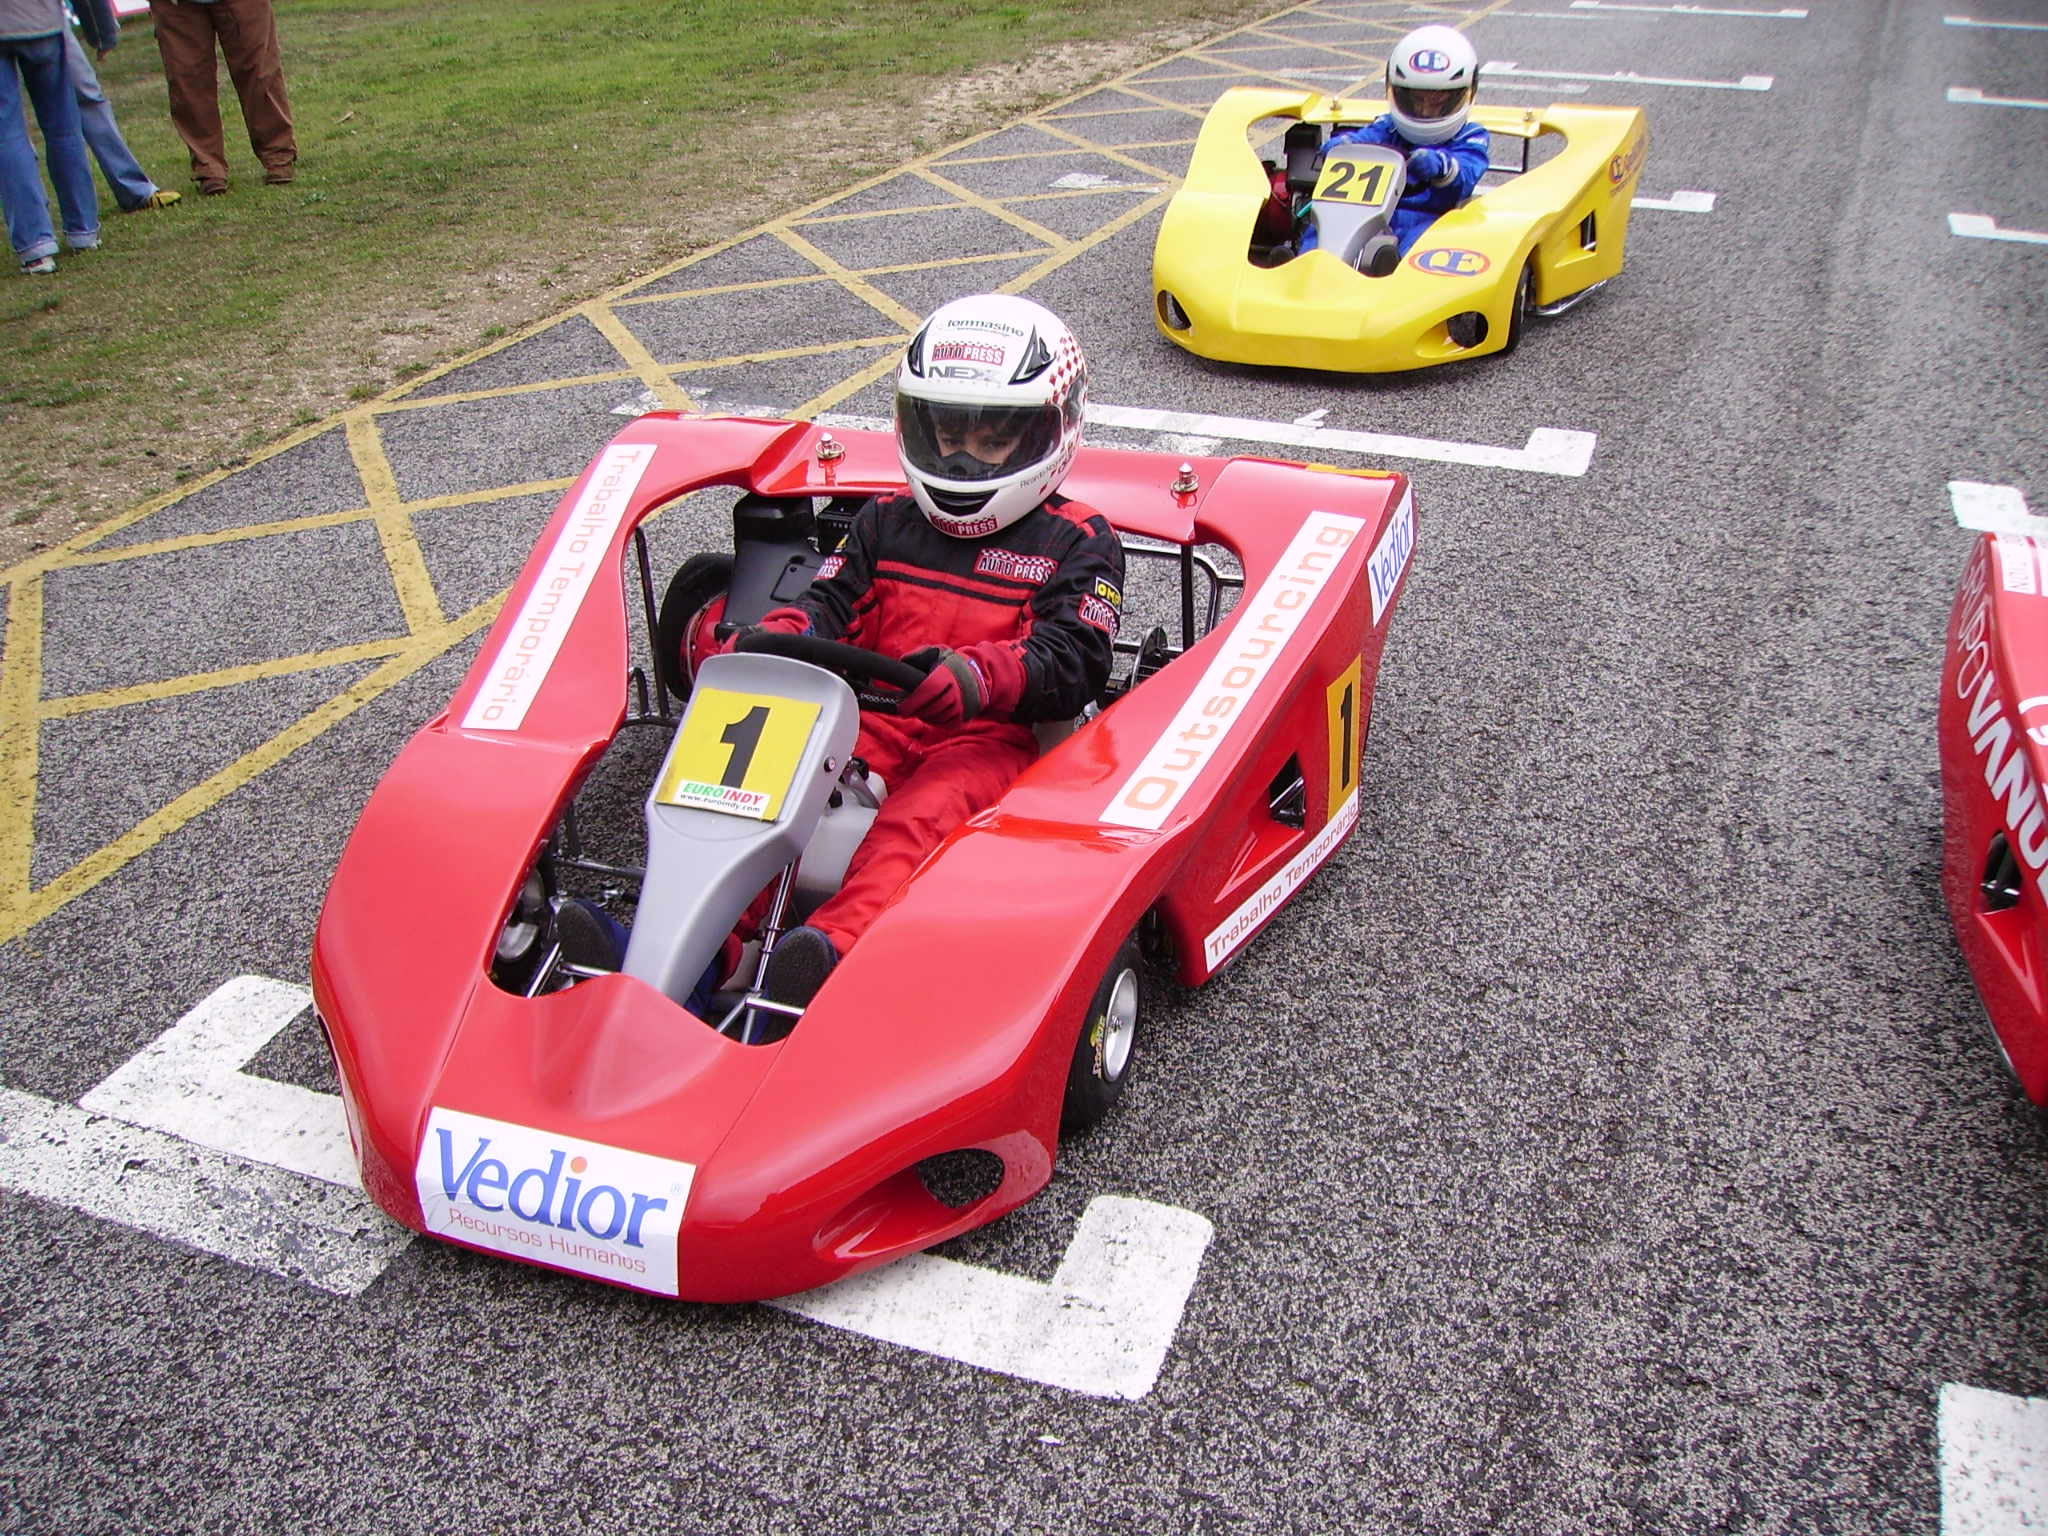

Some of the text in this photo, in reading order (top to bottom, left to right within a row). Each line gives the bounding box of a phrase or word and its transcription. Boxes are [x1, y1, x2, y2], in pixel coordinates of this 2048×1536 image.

[1321, 162, 1384, 202] 21
[962, 346, 1003, 366] PRESS
[569, 449, 641, 554] Trabalho
[958, 519, 996, 536] PRESS
[979, 556, 1052, 584] AUTO PRESS
[1371, 506, 1410, 608] Vedior
[1123, 525, 1356, 811] Outsourcing
[720, 706, 771, 788] 1
[1339, 680, 1353, 793] 1
[683, 782, 764, 805] EUROINDY
[1967, 670, 2048, 906] VANU
[1209, 802, 1357, 957] Trabalho Temporário
[436, 1127, 668, 1249] Vedior
[449, 1206, 647, 1273] Recursos Humanos
